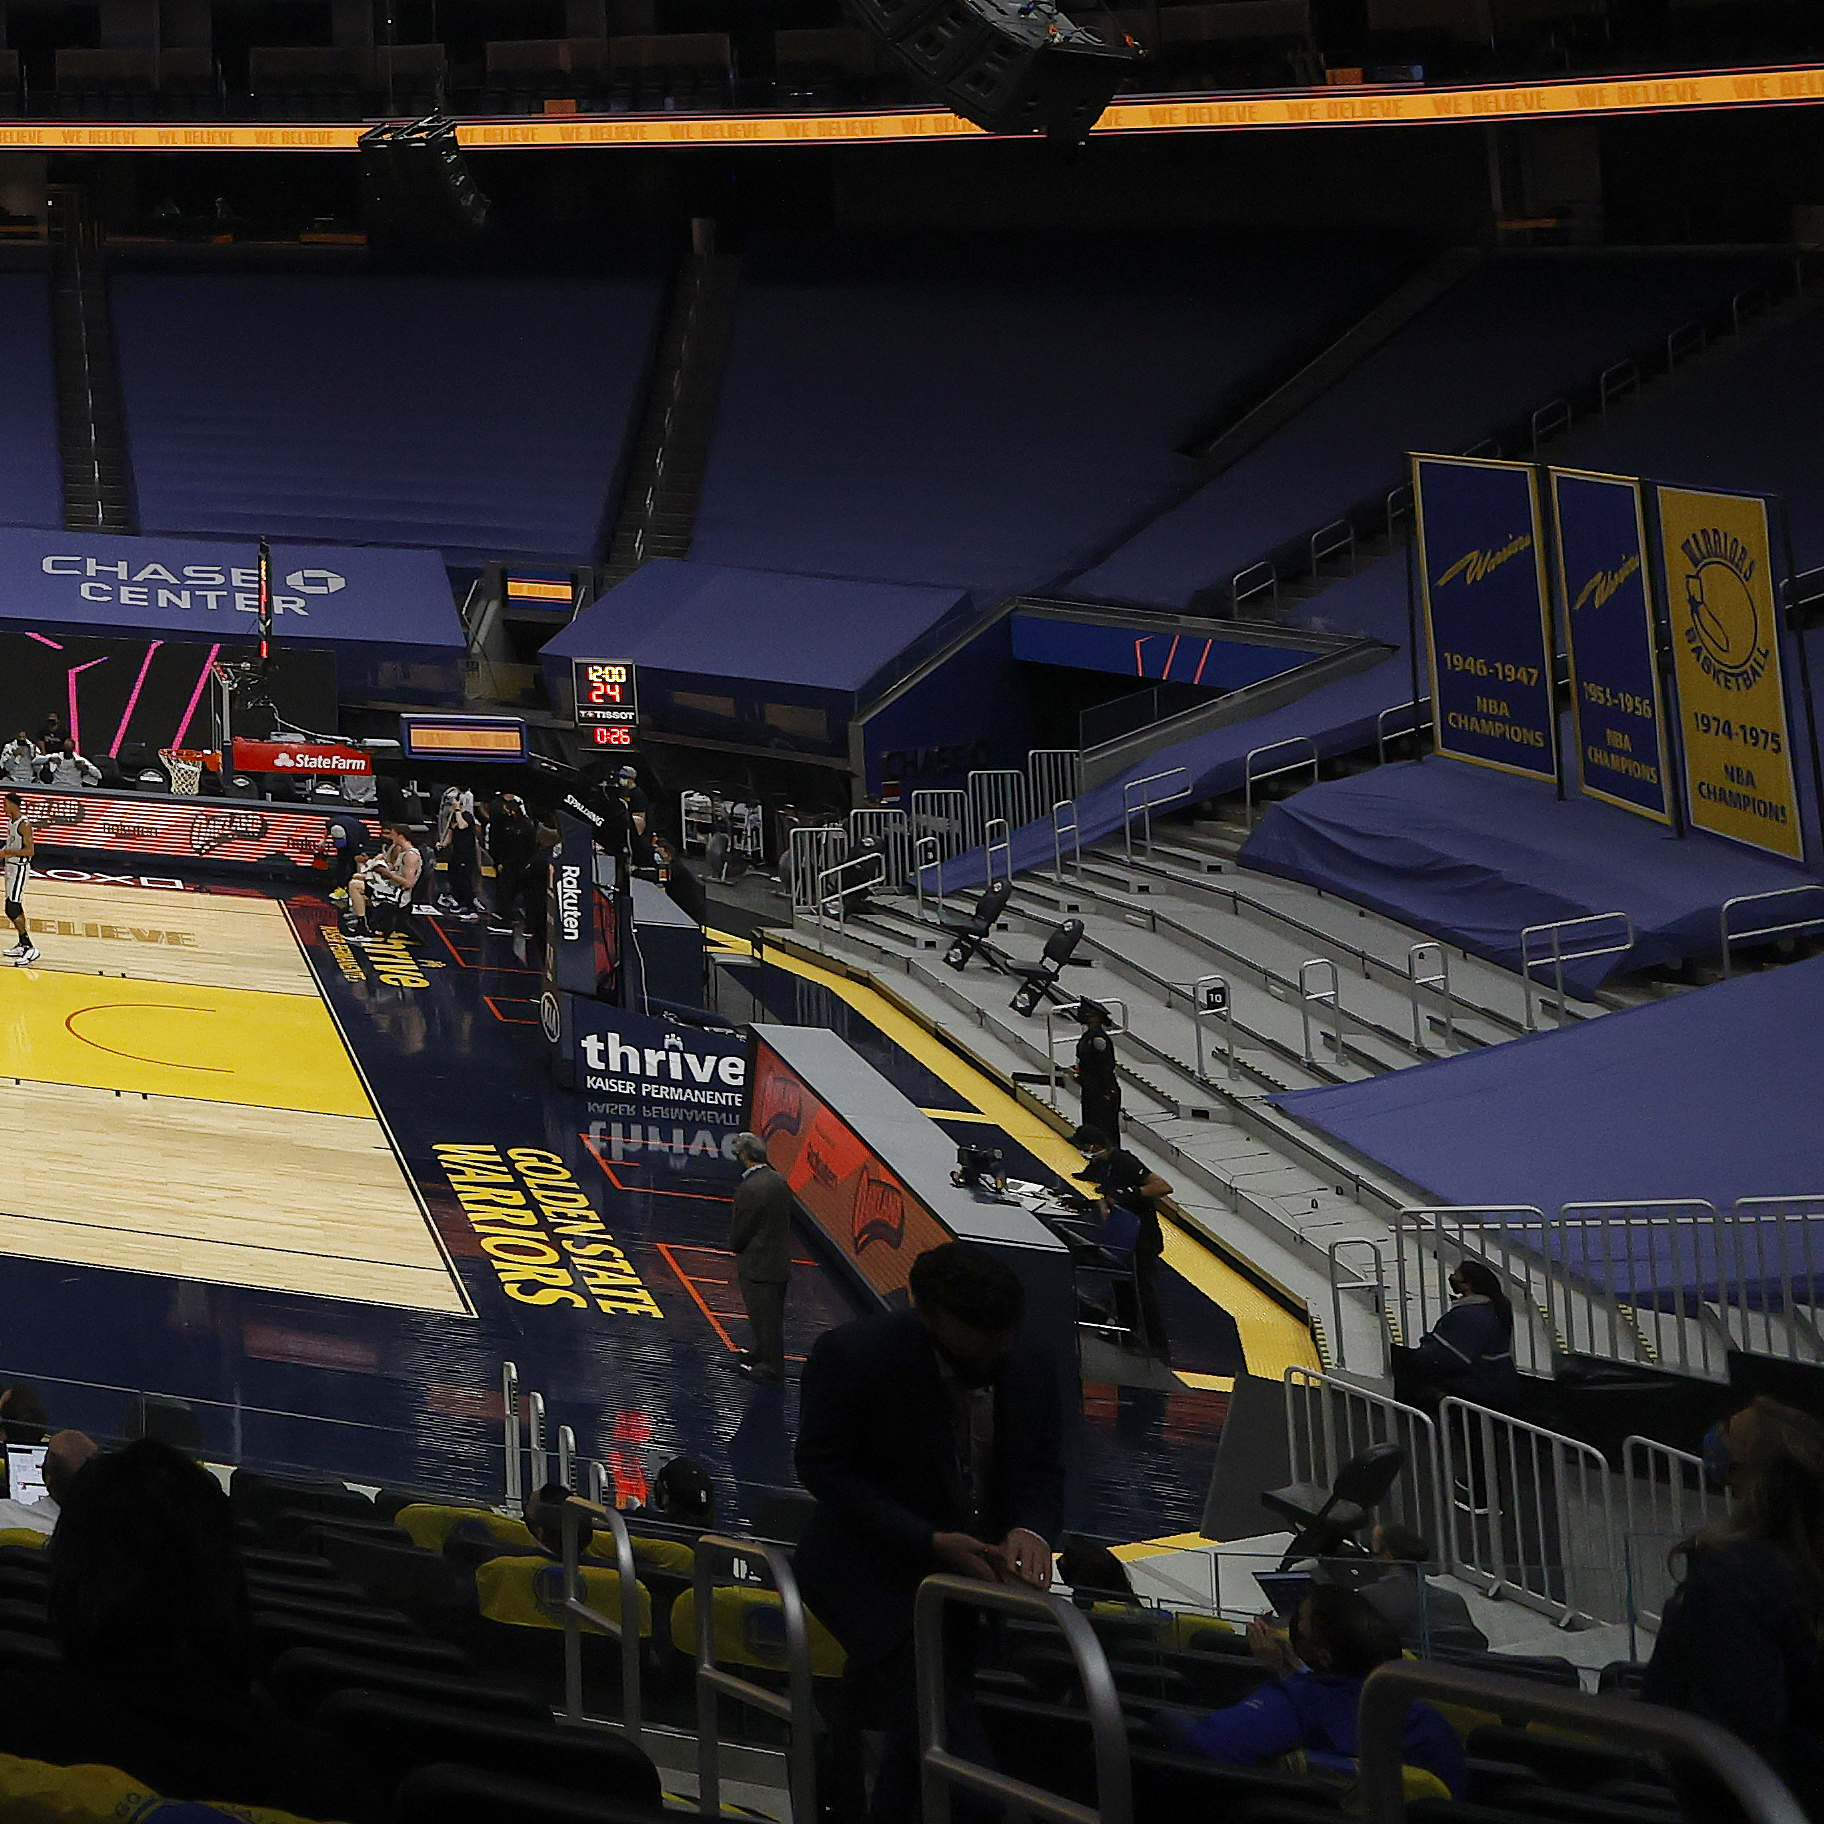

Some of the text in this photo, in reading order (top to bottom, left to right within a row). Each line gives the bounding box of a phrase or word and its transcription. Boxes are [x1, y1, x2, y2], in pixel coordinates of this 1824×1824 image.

[42, 556, 259, 587] CHASE
[81, 582, 309, 616] CENTER
[588, 666, 626, 682] 12:00
[1444, 652, 1539, 686] 1946-1947
[590, 682, 622, 703] 24
[1476, 697, 1510, 717] NBA
[595, 711, 634, 719] TISSOT
[1447, 712, 1545, 748] CHAMPIONS
[596, 727, 631, 744] 0:26
[295, 754, 366, 771] StateFarm
[564, 795, 604, 826] SPALDING
[561, 866, 580, 940] Rakuten
[581, 1032, 745, 1085] thrive
[586, 1076, 743, 1106] KAISER PERMANENTE
[432, 1144, 588, 1308] WARRIORS
[507, 1148, 664, 1318] GOLDEN STATE
